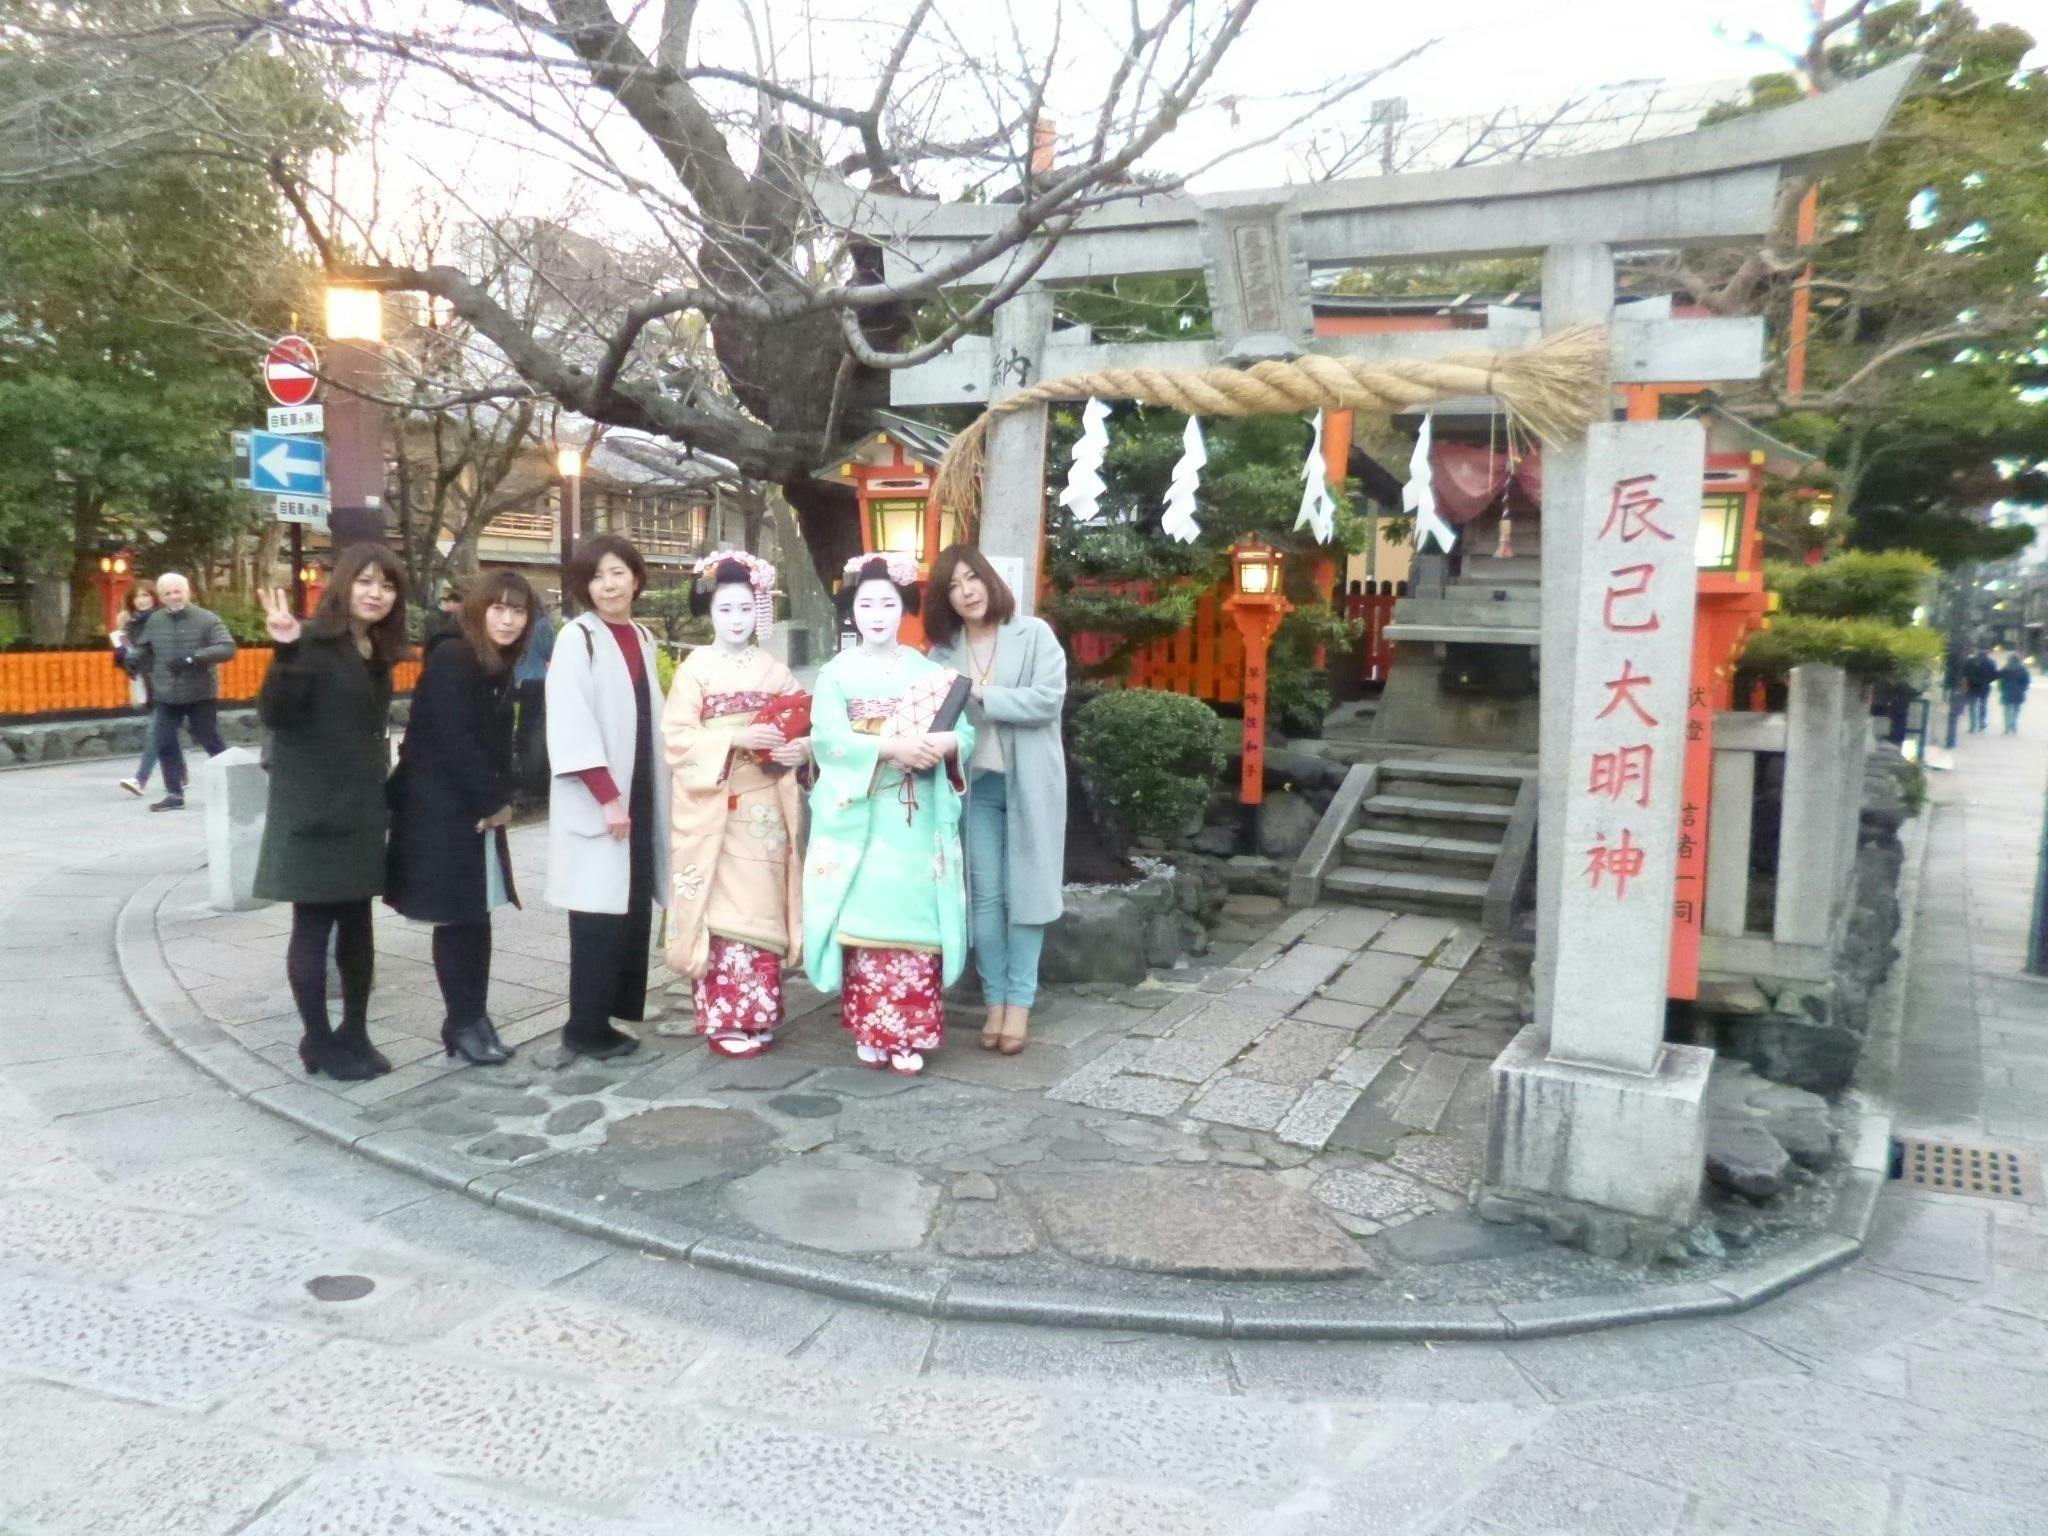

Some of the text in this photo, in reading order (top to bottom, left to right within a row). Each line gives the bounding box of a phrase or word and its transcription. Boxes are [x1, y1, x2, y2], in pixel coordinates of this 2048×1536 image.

[992, 347, 1033, 388] 納
[271, 411, 321, 428] 自転車を除く
